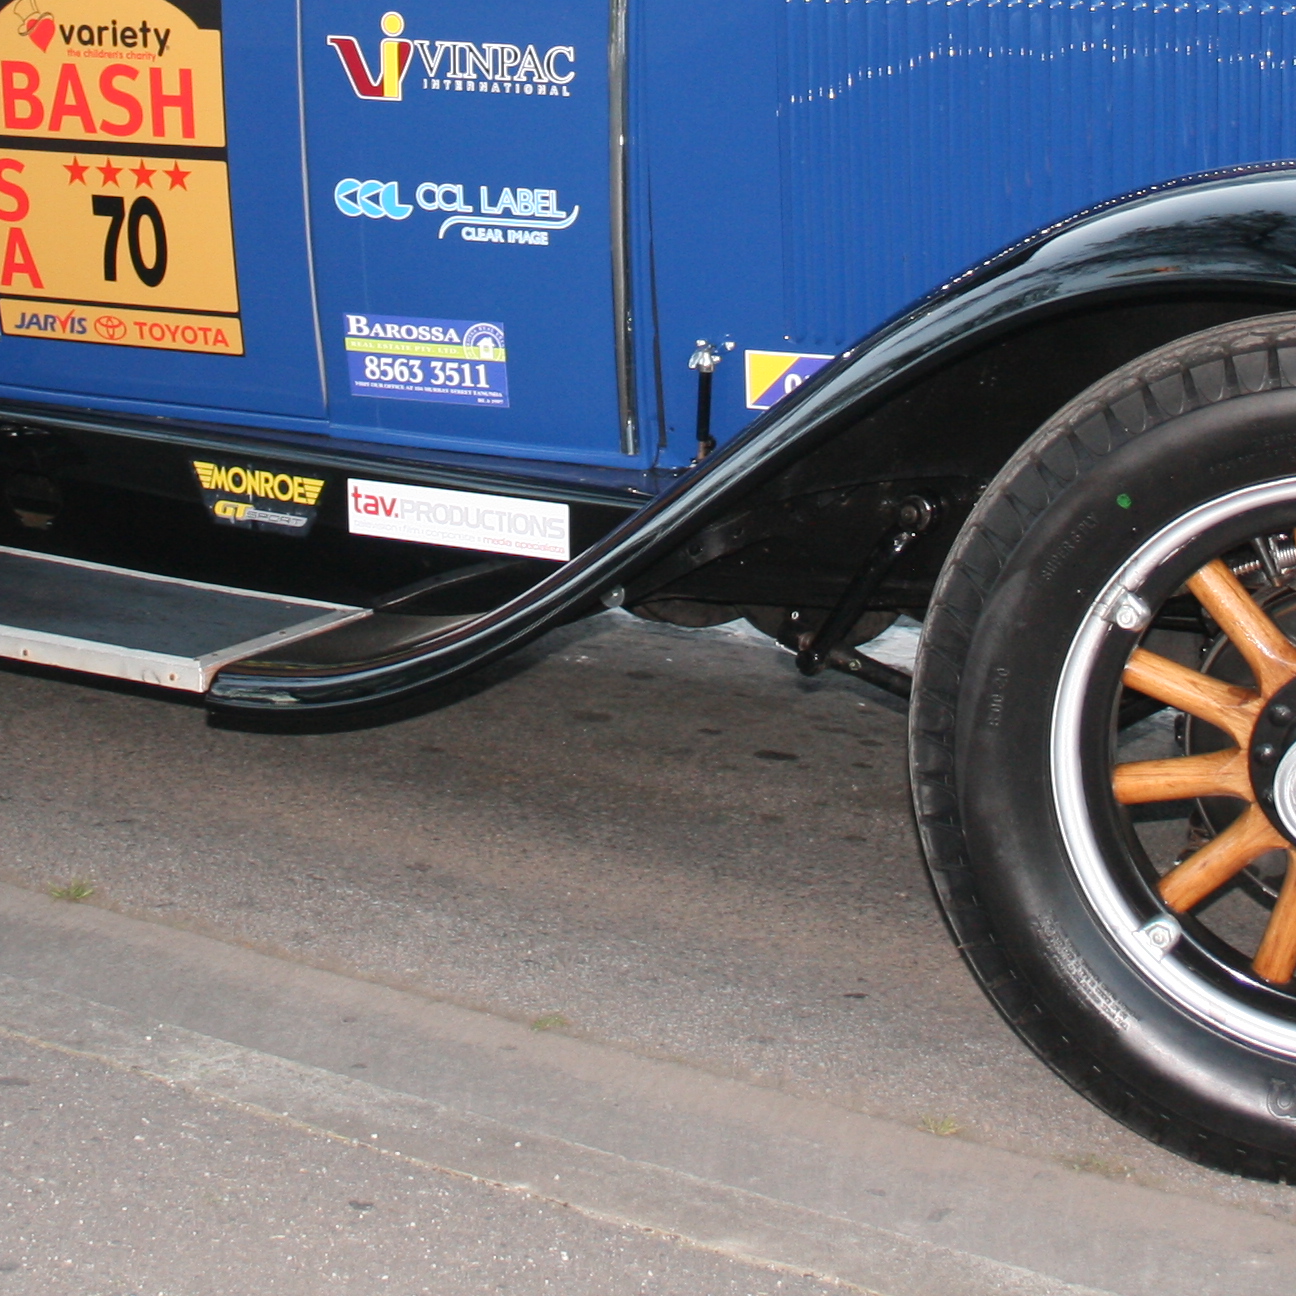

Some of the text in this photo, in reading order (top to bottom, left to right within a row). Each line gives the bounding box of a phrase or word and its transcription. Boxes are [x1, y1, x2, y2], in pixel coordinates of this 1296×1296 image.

[59, 19, 171, 57] variety
[67, 48, 157, 63] the children's charity
[413, 39, 576, 85] VINPAC
[1, 60, 195, 139] BASH
[422, 78, 571, 97] INTERNATIONAL
[416, 182, 473, 213] CCL
[479, 185, 567, 218] LABEL
[91, 194, 168, 288] 70
[461, 226, 549, 246] CLEAR IMAGE
[14, 309, 230, 348] JARVIS TOYOTA
[350, 340, 375, 349] REAL
[377, 343, 411, 352] ESTATE
[364, 355, 490, 389] 8563 3511
[209, 464, 308, 505] MONROE
[483, 535, 512, 547] media
[514, 540, 566, 555] specialists
